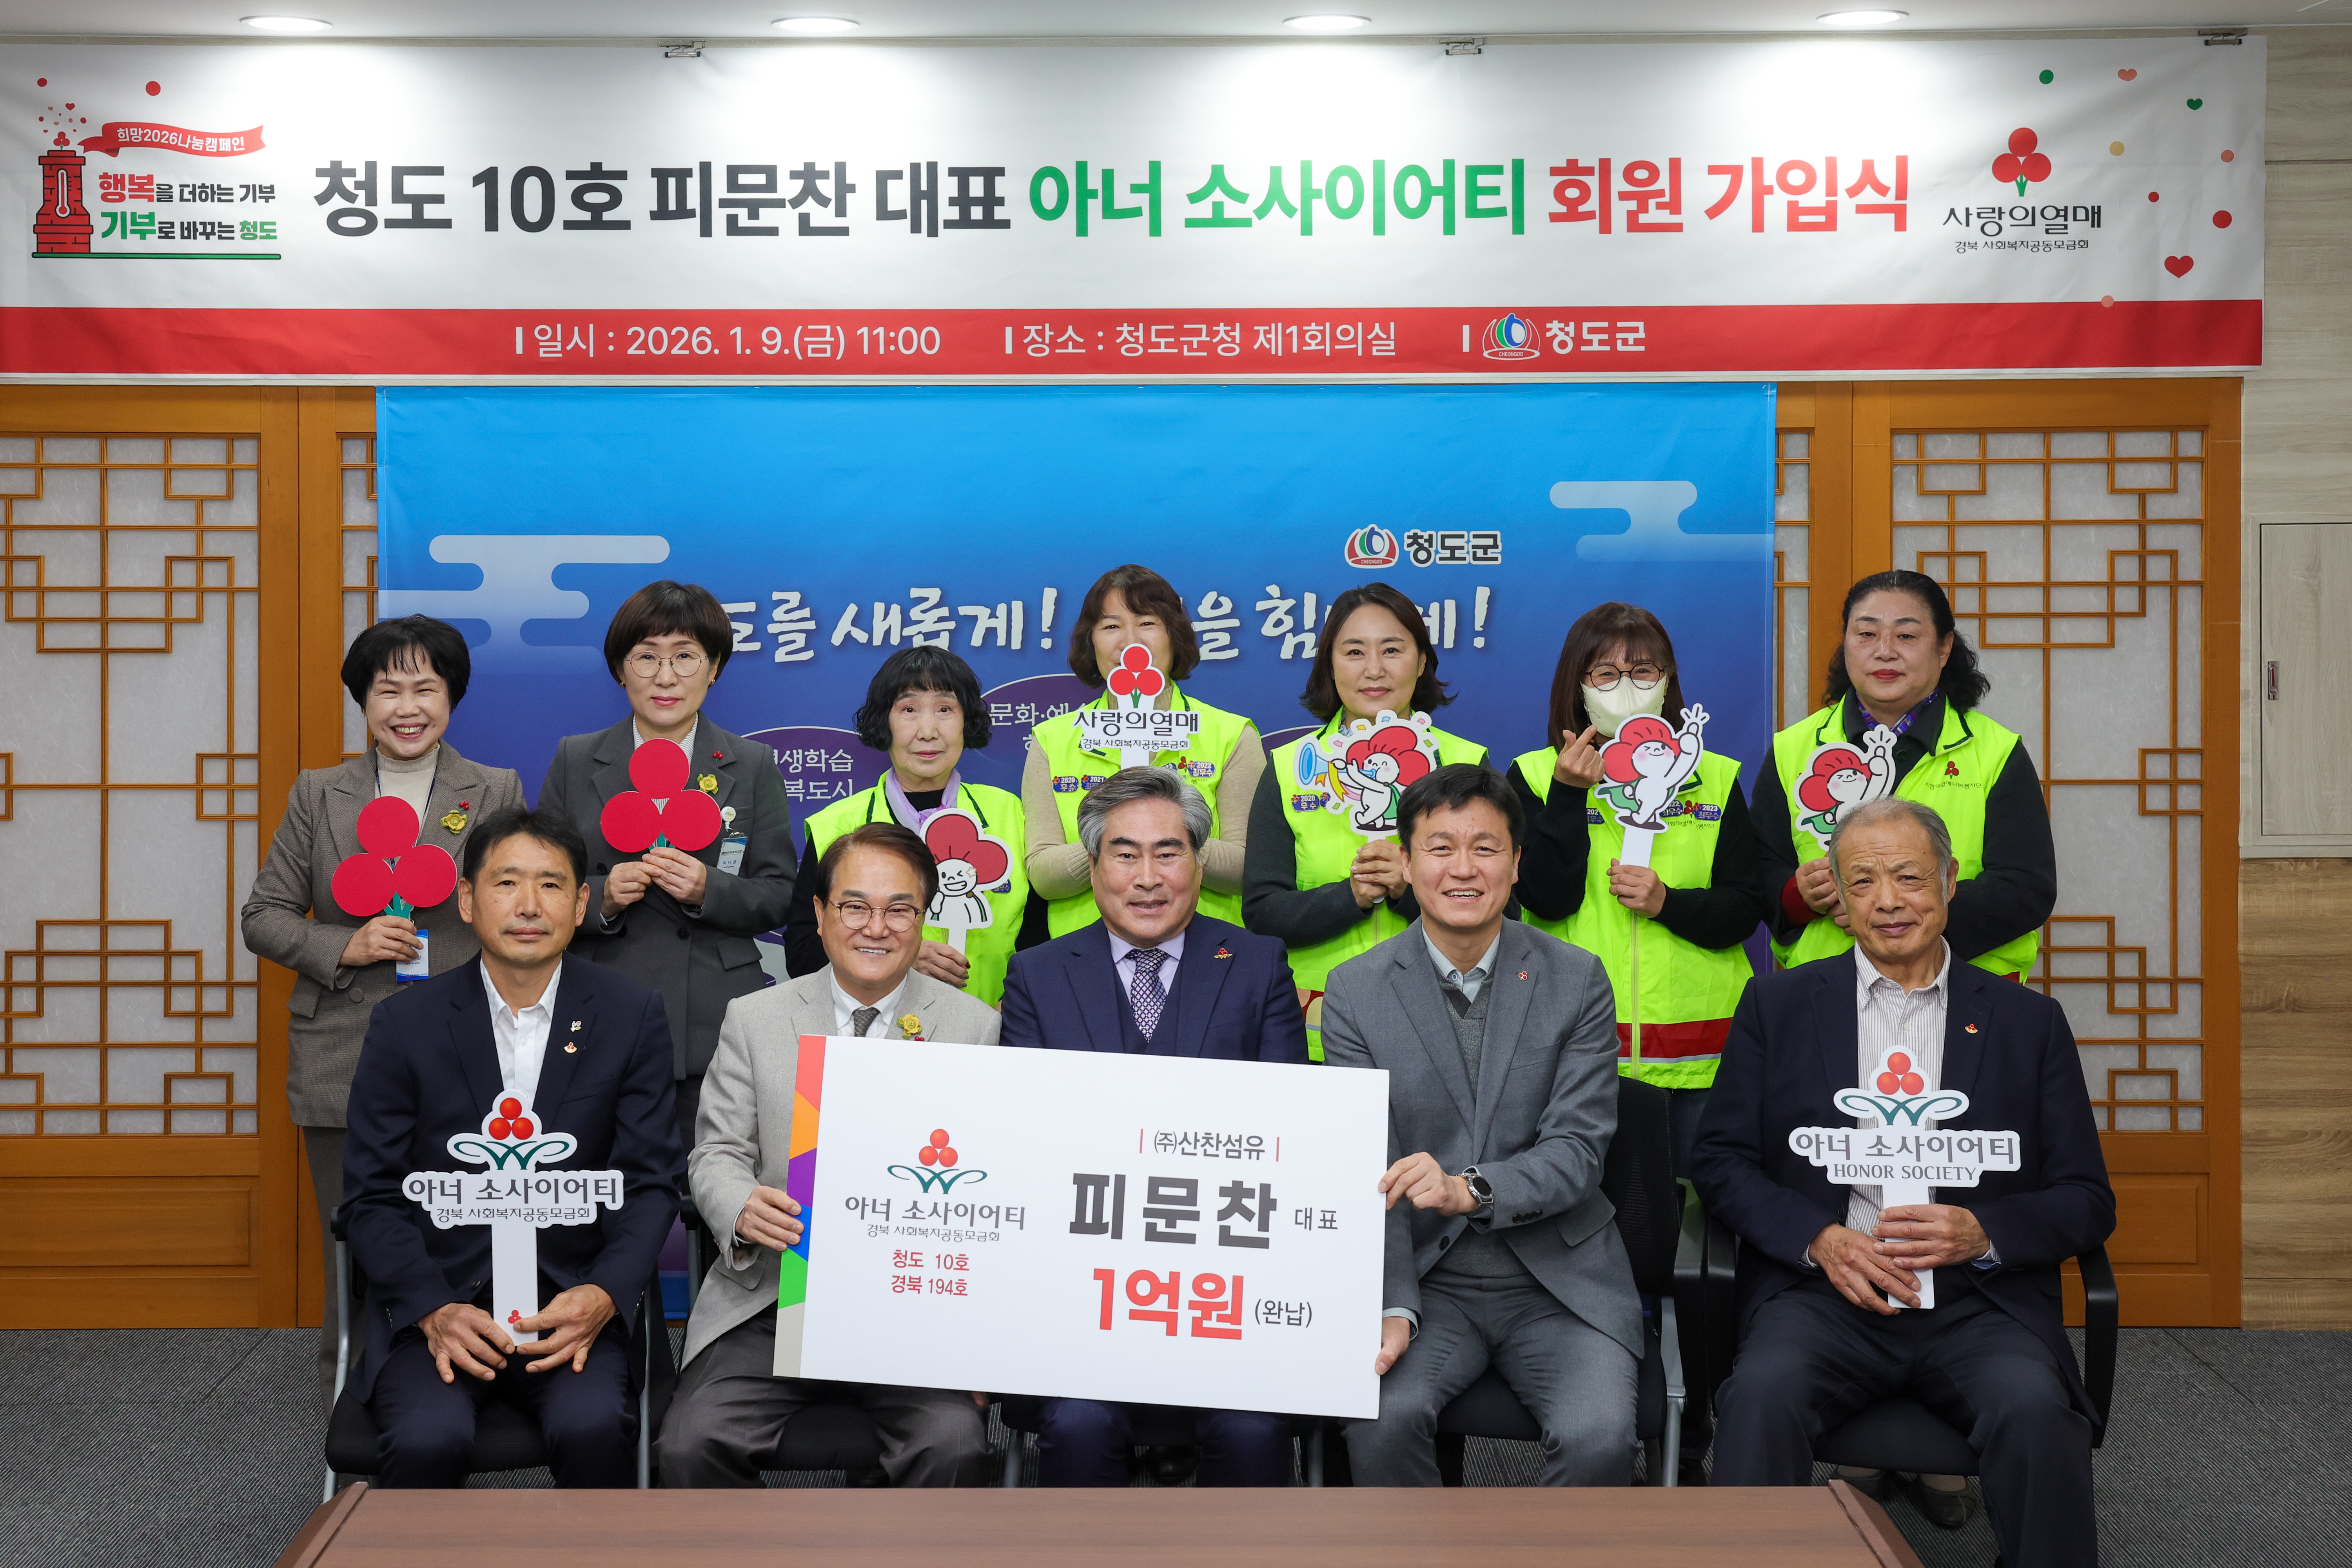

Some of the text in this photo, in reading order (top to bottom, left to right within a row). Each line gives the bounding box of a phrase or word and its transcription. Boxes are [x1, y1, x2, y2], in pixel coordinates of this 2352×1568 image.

[117, 128, 245, 152] 희망2026나눔캠페인
[99, 172, 275, 203] 행복을 더하는 기부
[314, 156, 1907, 237] 청도 10호 피문찬 대표 아너 소사이어티 회원 가입식
[101, 212, 277, 240] 기부로 바꾸는 청도
[1943, 205, 2101, 236] 사랑의열매
[1956, 240, 2088, 253] 경북 사회복지공동모금회
[534, 324, 593, 357] 일시
[627, 327, 719, 354] 2026.
[730, 327, 751, 354] 1.
[762, 325, 844, 359] 9.(금)
[857, 327, 940, 354] 11:00
[1023, 323, 1085, 357] 장소
[1116, 323, 1240, 356] 청도군청
[1253, 322, 1396, 356] 제1회의실
[1546, 320, 1645, 354] 청도군
[1406, 532, 1499, 564] 청도군
[720, 591, 817, 662] 도를
[1192, 590, 1241, 661] 을
[1074, 711, 1198, 736] 사랑의열매
[1083, 739, 1188, 750] 경북 사회복지공동모금회
[773, 749, 854, 773] 생학습
[1193, 768, 1214, 777] 최우수
[1796, 1134, 2014, 1164] 아너 소사이어티
[1834, 1164, 1976, 1180] HONOR SOCIETY
[409, 1178, 616, 1205] 아너 소사이어티
[437, 1207, 590, 1222] 경북 사회복지공동모금회
[846, 1197, 1025, 1230] 아너 소사이어티
[1295, 1208, 1338, 1230] 대표
[867, 1225, 1000, 1243] 경북 사회복지공동모금회
[893, 1250, 969, 1270] 청도 10호
[891, 1275, 967, 1296] 경북 194호
[1094, 1269, 1312, 1340] 1억원 (완납)
